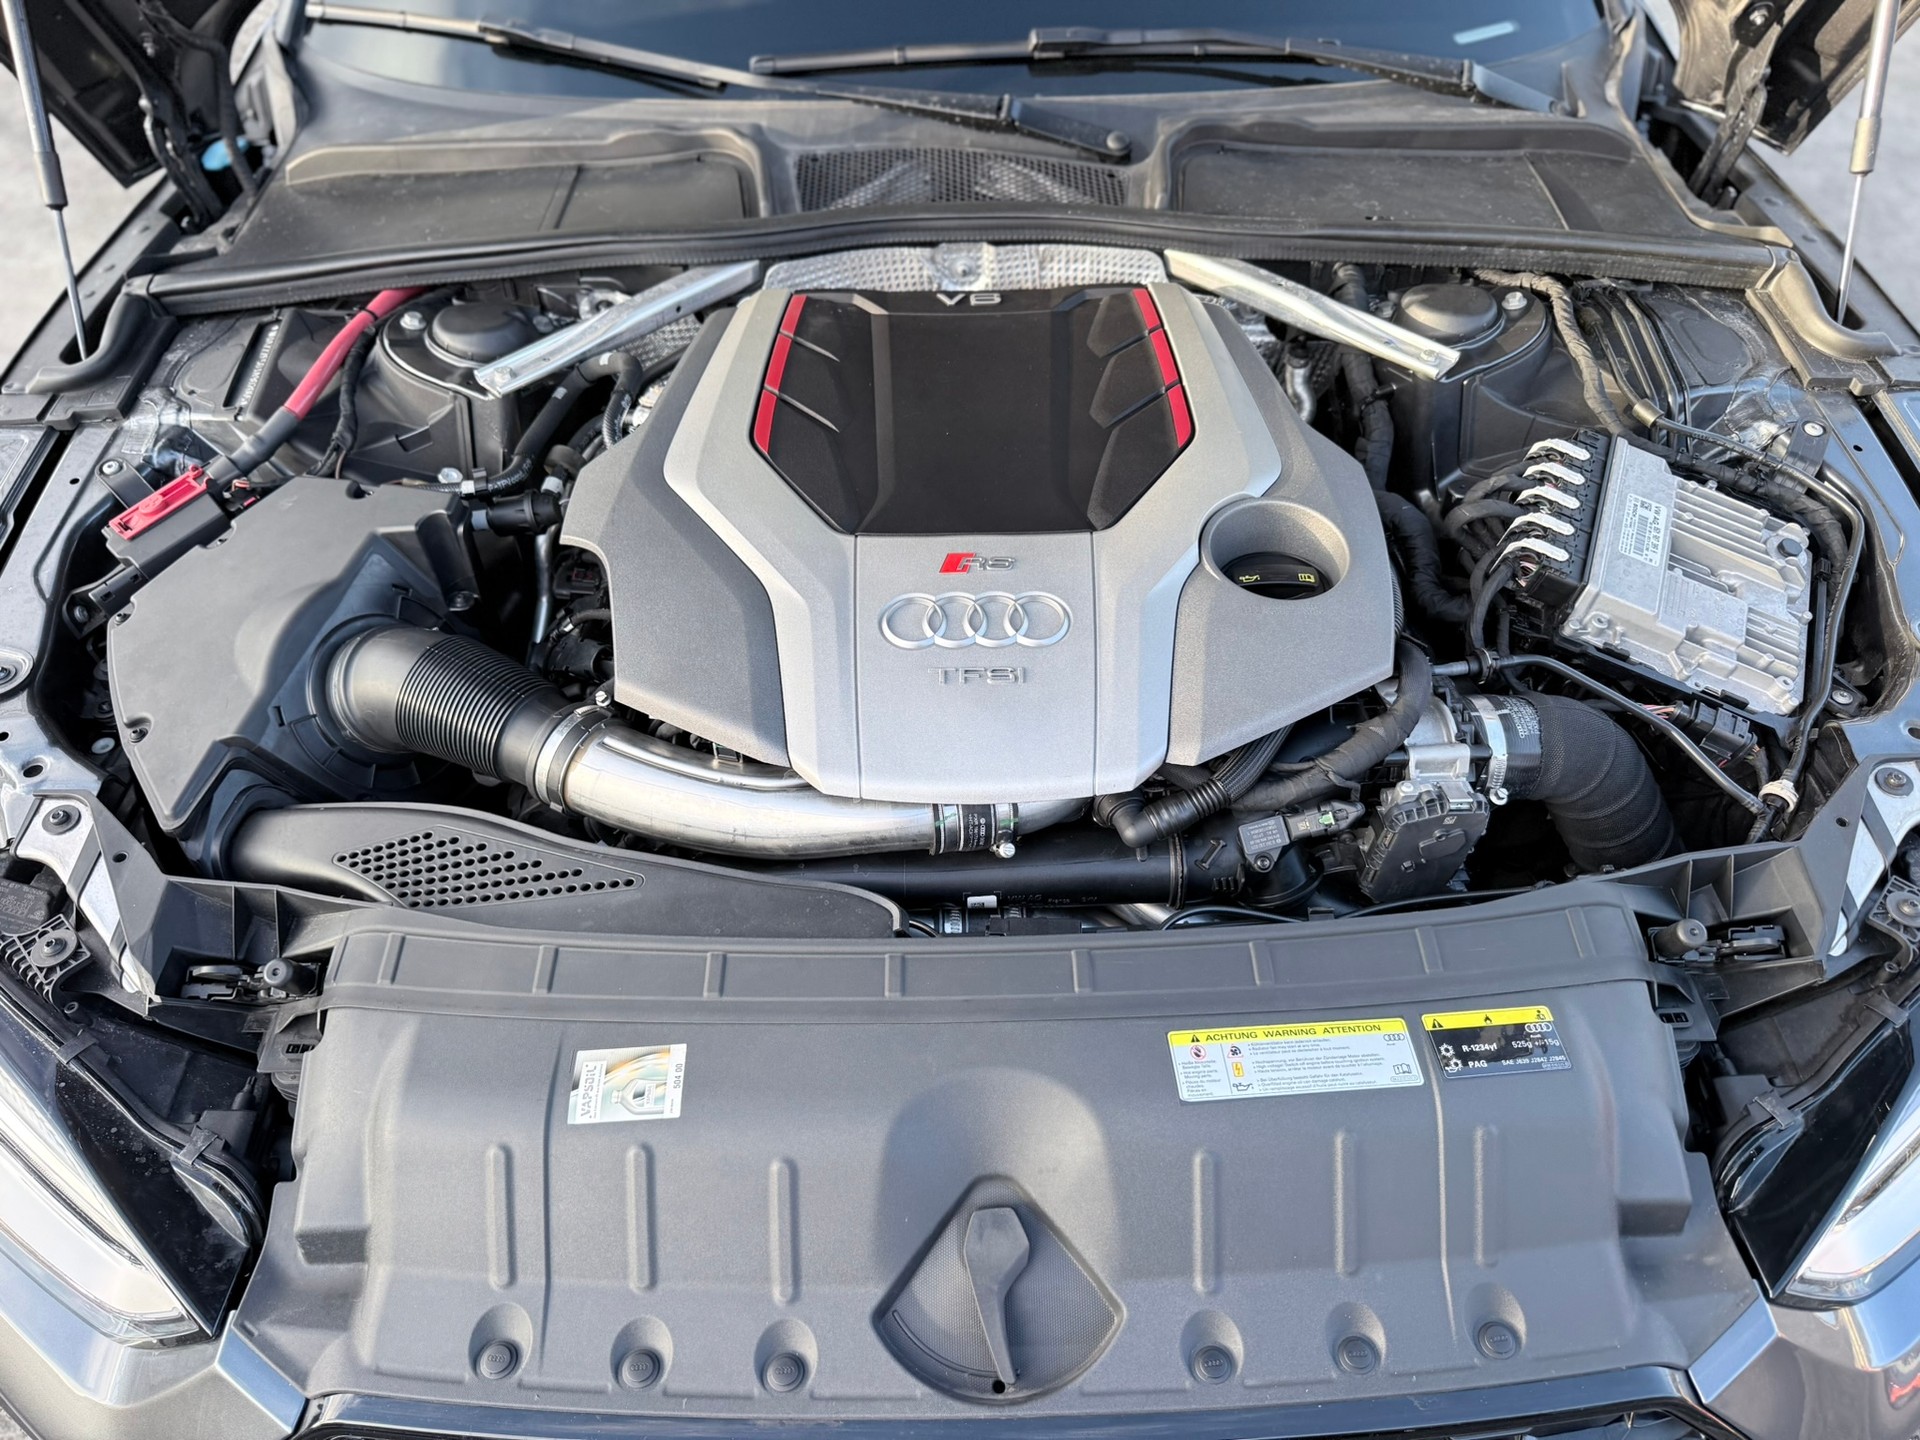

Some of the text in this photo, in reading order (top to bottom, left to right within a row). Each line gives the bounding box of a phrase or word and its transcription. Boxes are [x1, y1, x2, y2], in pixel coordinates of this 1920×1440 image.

[936, 292, 1001, 307] V6
[955, 555, 1016, 572] RS
[928, 666, 1027, 686] TFSI
[1204, 1024, 1381, 1041] ACHTUNG WARNING ATTENTION
[1462, 1043, 1498, 1054] R-1234yf
[1511, 1040, 1533, 1049] 525g
[1468, 1060, 1488, 1069] PAG
[673, 1063, 684, 1089] 504 00
